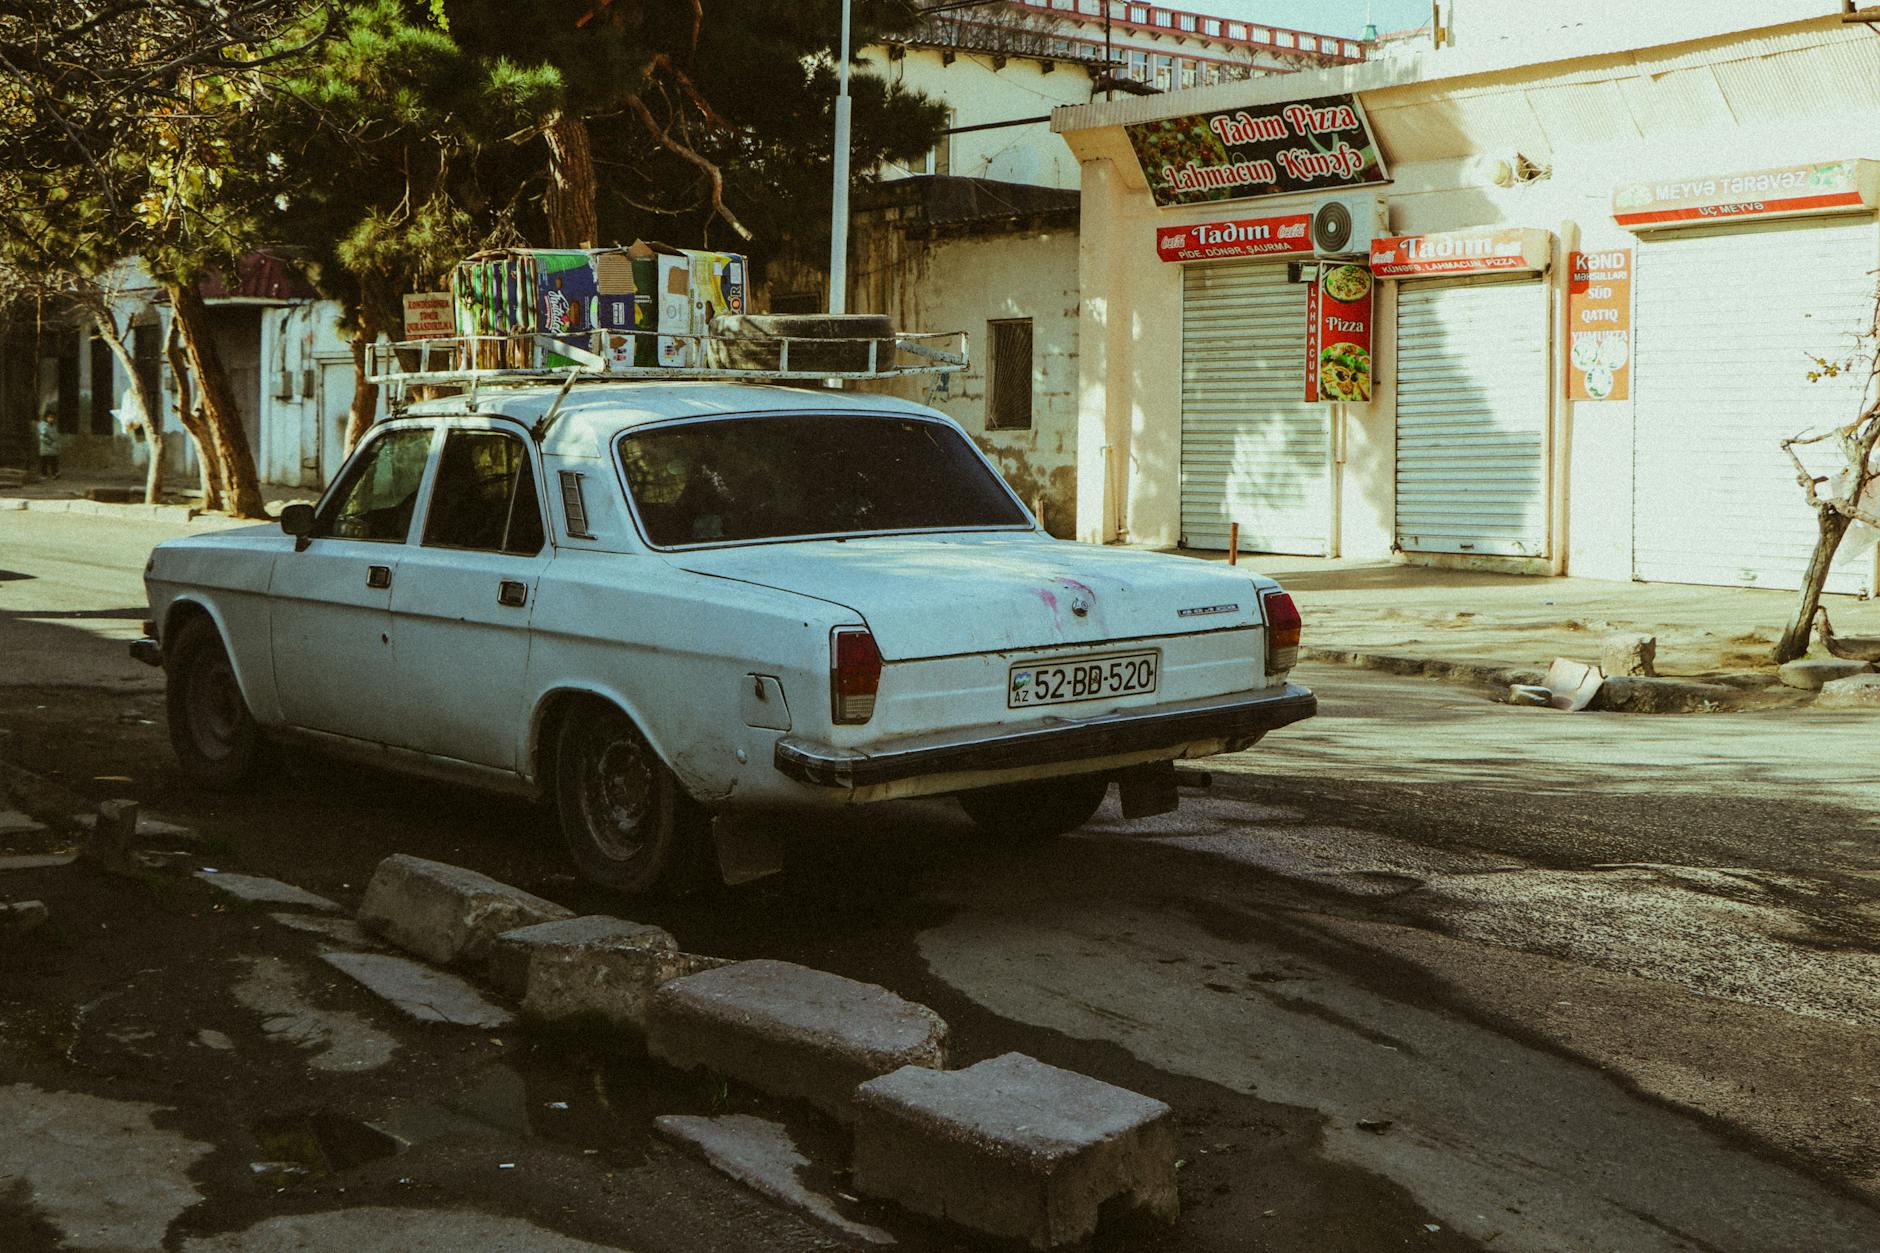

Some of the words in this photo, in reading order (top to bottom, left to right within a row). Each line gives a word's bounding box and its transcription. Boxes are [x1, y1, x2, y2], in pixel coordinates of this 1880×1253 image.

[1211, 111, 1288, 146] Tadım
[1284, 103, 1358, 136] Pizza
[1162, 158, 1276, 193] Lahmacun
[1277, 142, 1364, 181] Künəfə
[1655, 181, 1717, 201] MEYVƏ
[1720, 170, 1808, 194] TƏRƏVƏZ
[1721, 202, 1765, 214] MEYVƏ
[1191, 222, 1271, 245] Tadım
[1399, 236, 1493, 260] Tadım
[1576, 252, 1625, 271] KƏND
[1587, 285, 1612, 300] SÜD
[1326, 316, 1364, 333] Pizza
[1581, 308, 1619, 323] QATIQ
[1308, 288, 1317, 383] LAHMACUN
[1014, 690, 1029, 702] AZ
